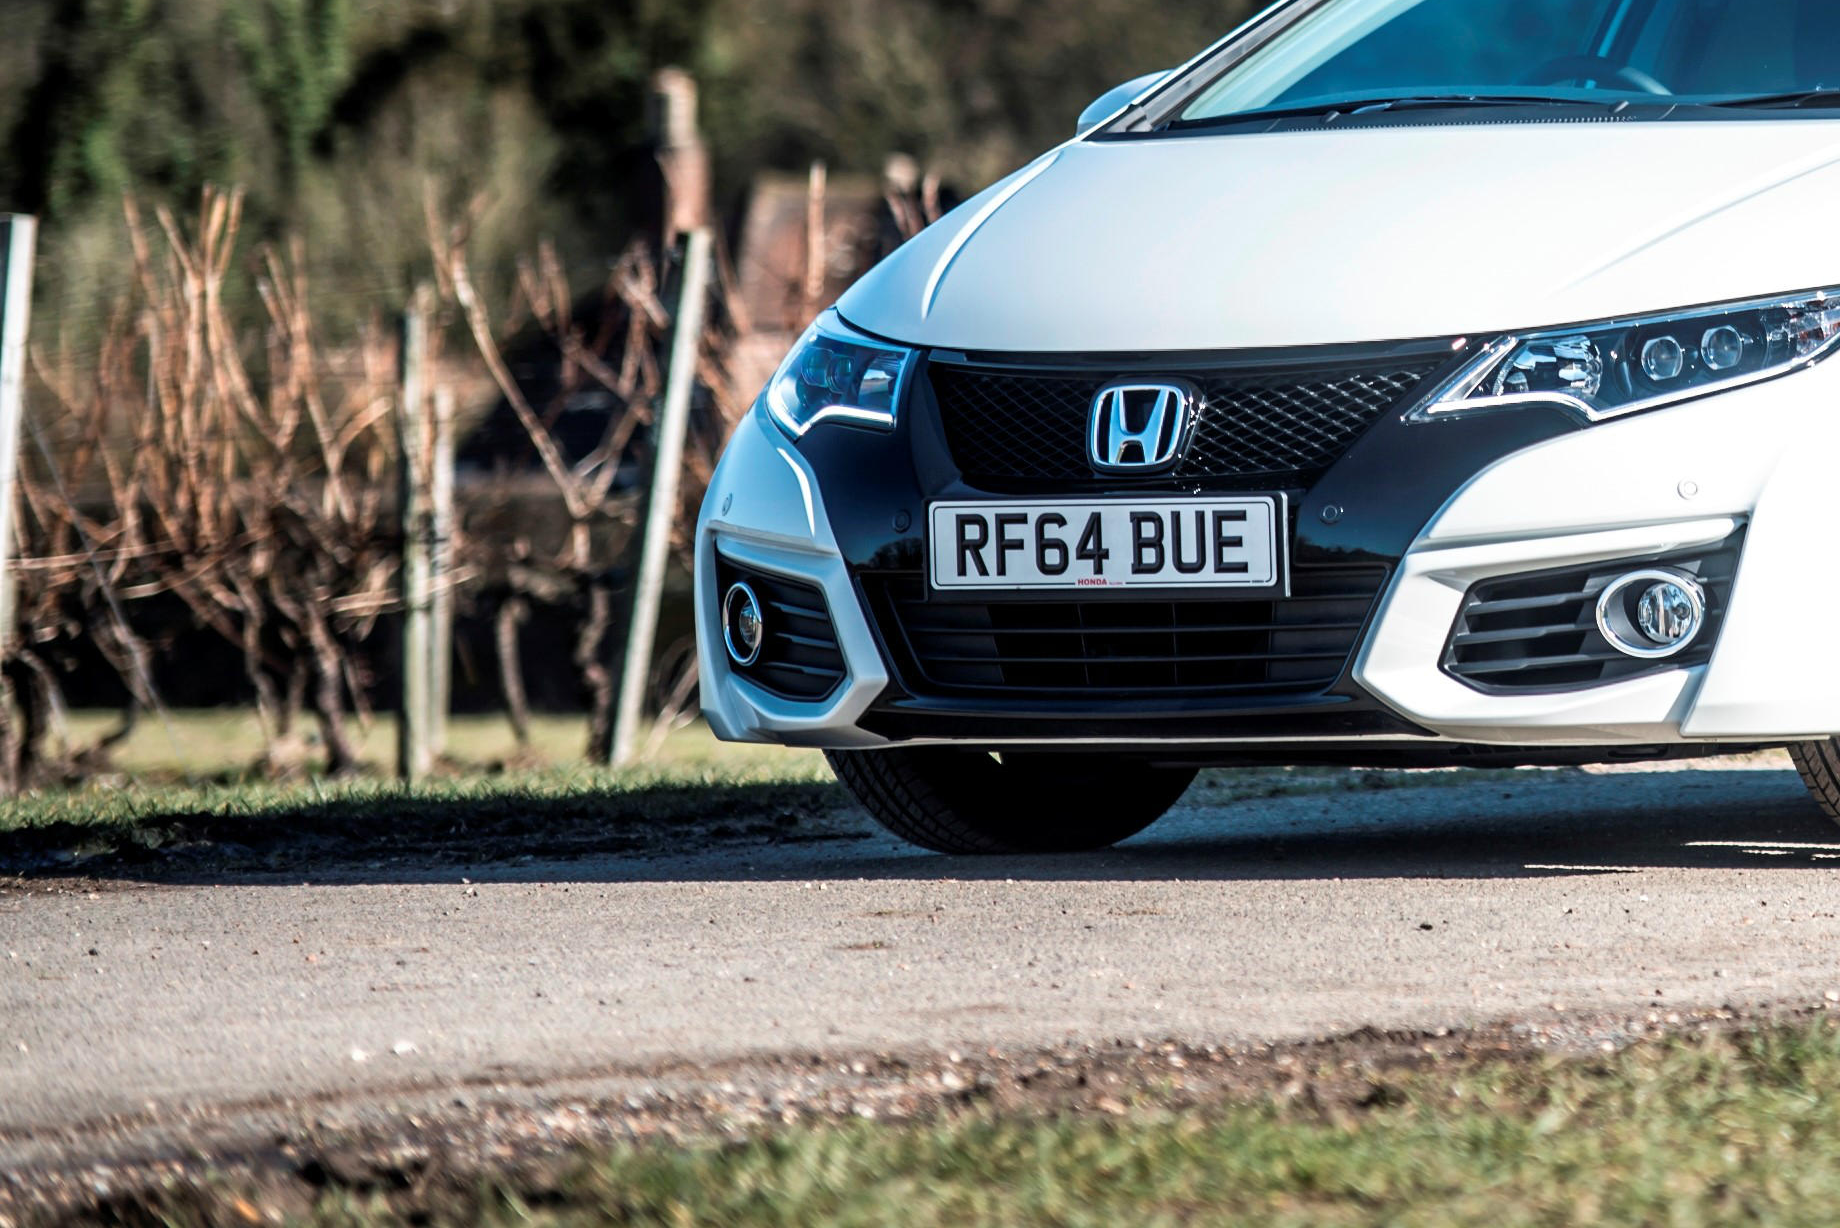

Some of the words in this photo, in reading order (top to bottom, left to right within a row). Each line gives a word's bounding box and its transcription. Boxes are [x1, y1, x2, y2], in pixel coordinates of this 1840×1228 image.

[955, 512, 1109, 577] RF64
[1129, 510, 1248, 574] BUE
[1077, 578, 1107, 586] HONDA
